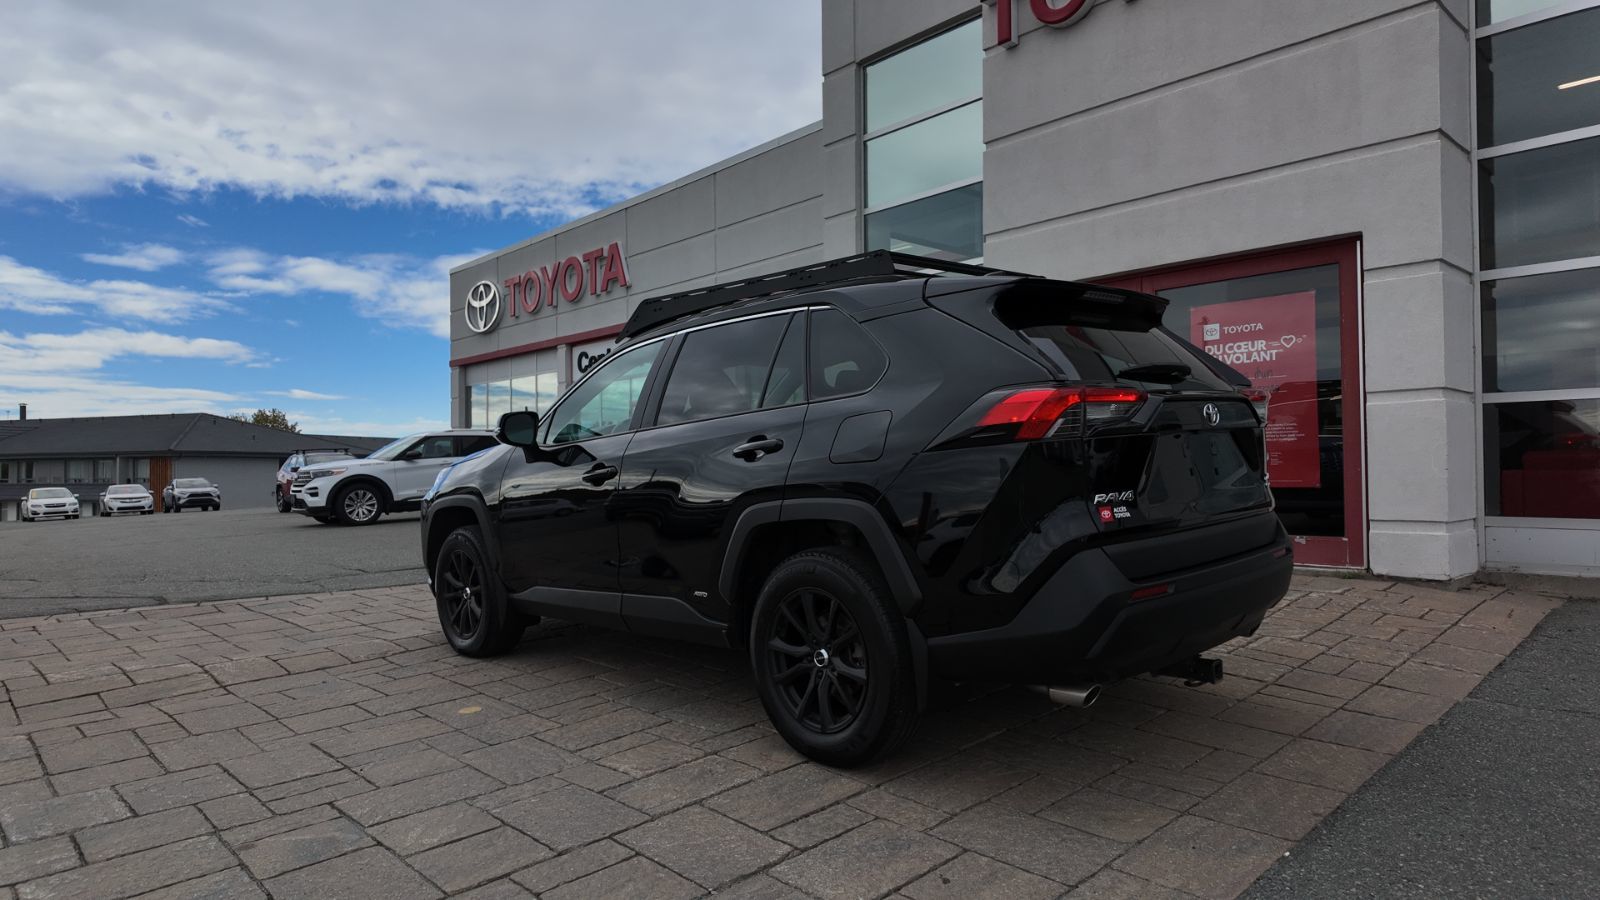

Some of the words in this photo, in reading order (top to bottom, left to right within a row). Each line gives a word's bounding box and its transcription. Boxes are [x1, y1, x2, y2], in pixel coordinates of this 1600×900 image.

[504, 240, 630, 318] TOYOTA
[1223, 323, 1263, 334] TOYOTA
[1205, 344, 1223, 355] DU
[1224, 350, 1278, 364] VOLANT
[1094, 490, 1134, 504] RAV4
